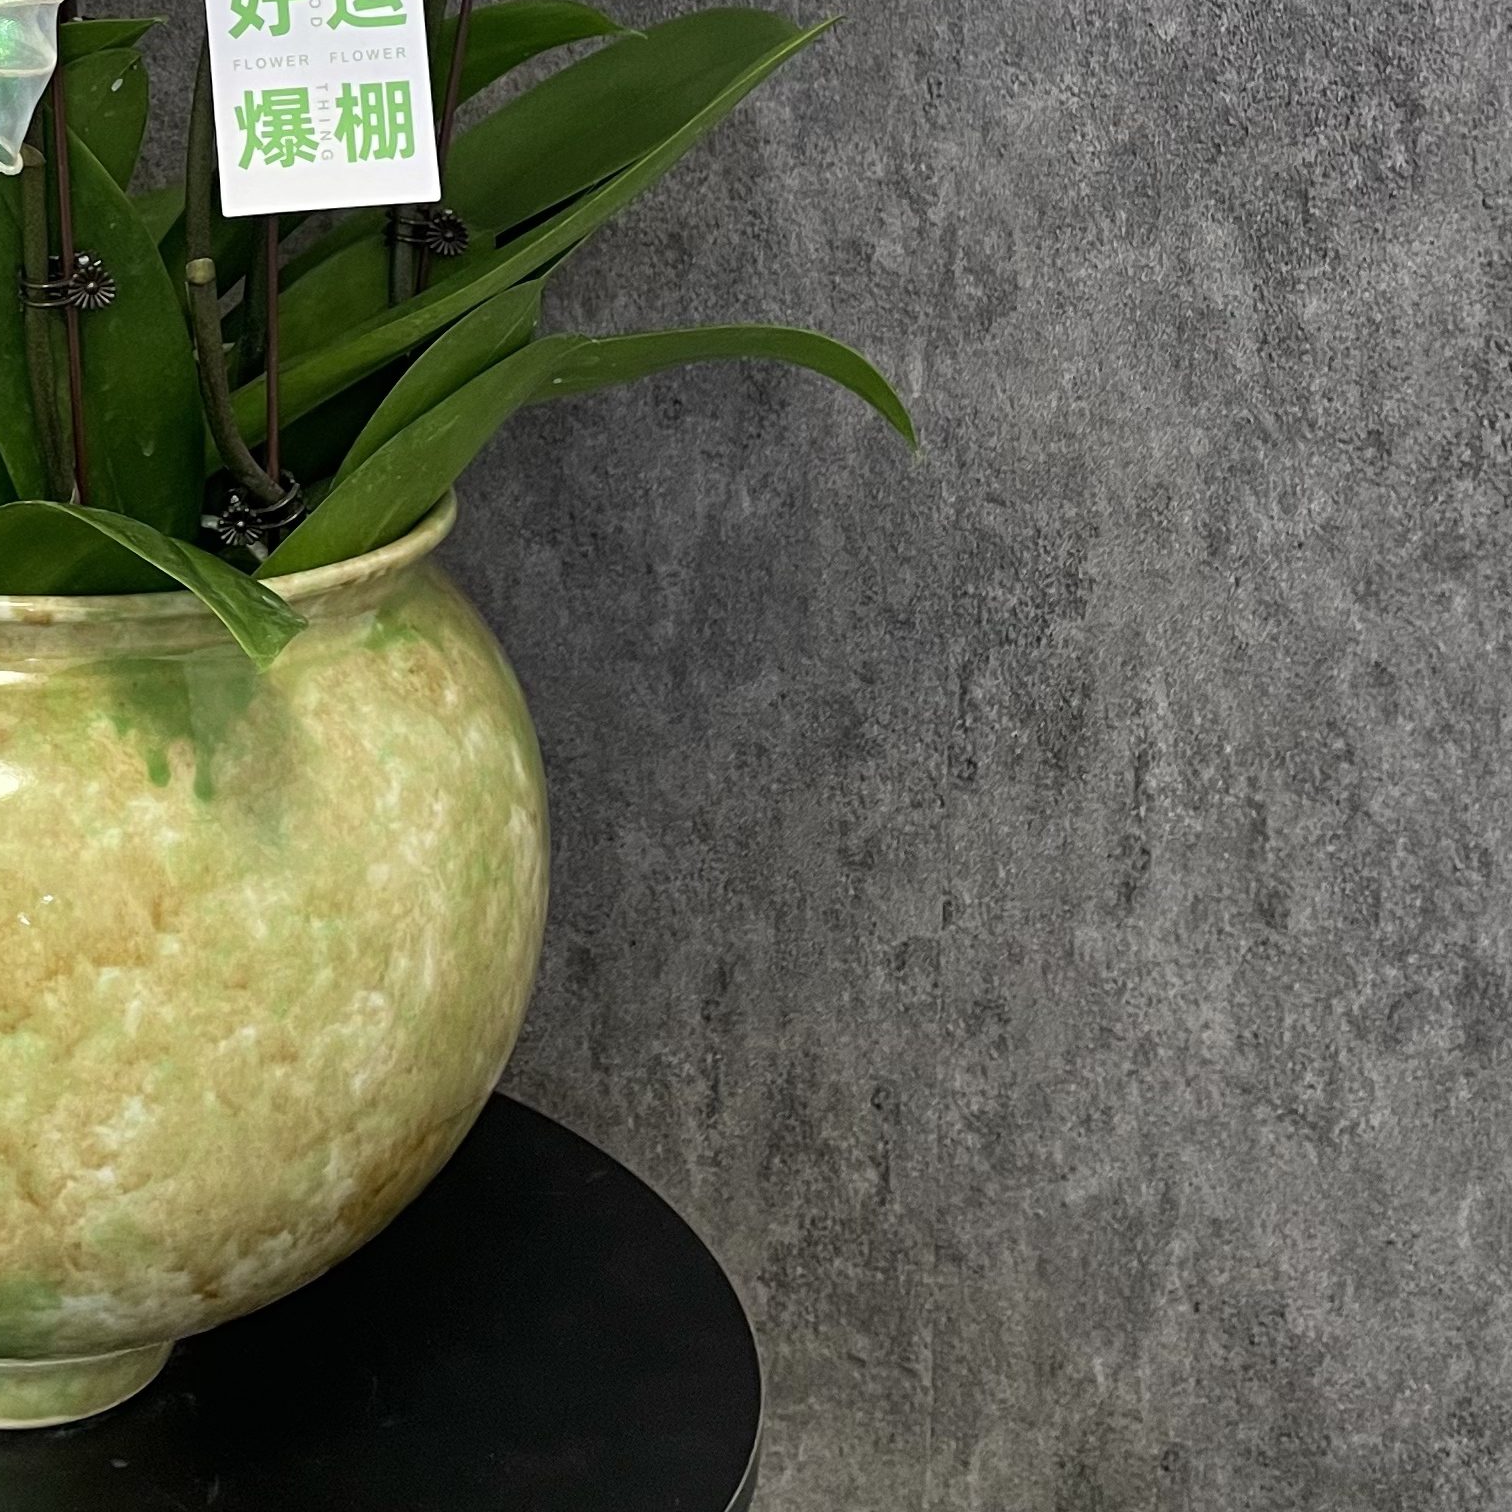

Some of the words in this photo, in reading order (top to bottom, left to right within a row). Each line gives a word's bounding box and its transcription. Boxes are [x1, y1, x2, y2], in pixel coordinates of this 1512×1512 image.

[233, 54, 309, 71] FLOWER
[330, 47, 407, 64] FLOWER
[234, 80, 415, 170] 爆棚
[315, 83, 333, 160] THING
